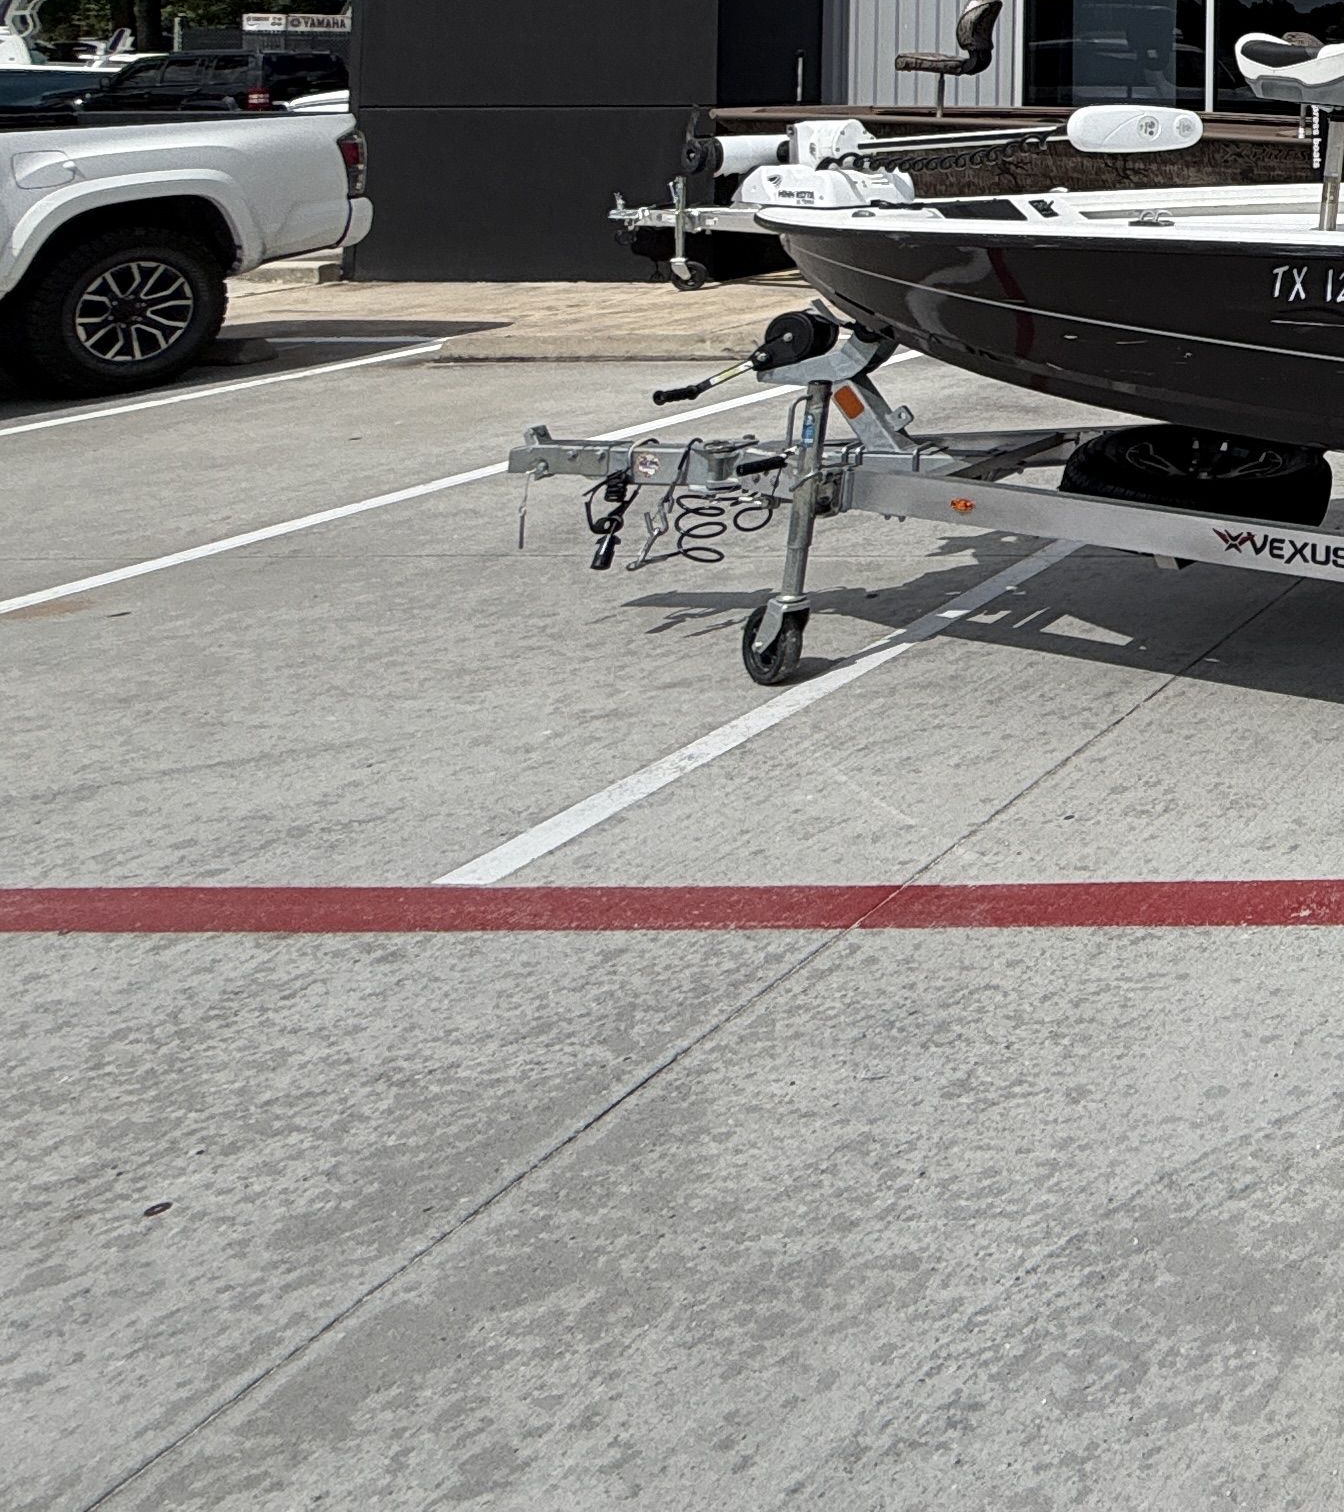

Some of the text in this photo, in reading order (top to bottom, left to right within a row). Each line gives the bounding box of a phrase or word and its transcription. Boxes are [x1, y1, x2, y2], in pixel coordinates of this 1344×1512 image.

[303, 18, 347, 29] YAMAHA
[1312, 138, 1322, 169] boats
[1272, 265, 1308, 302] TX
